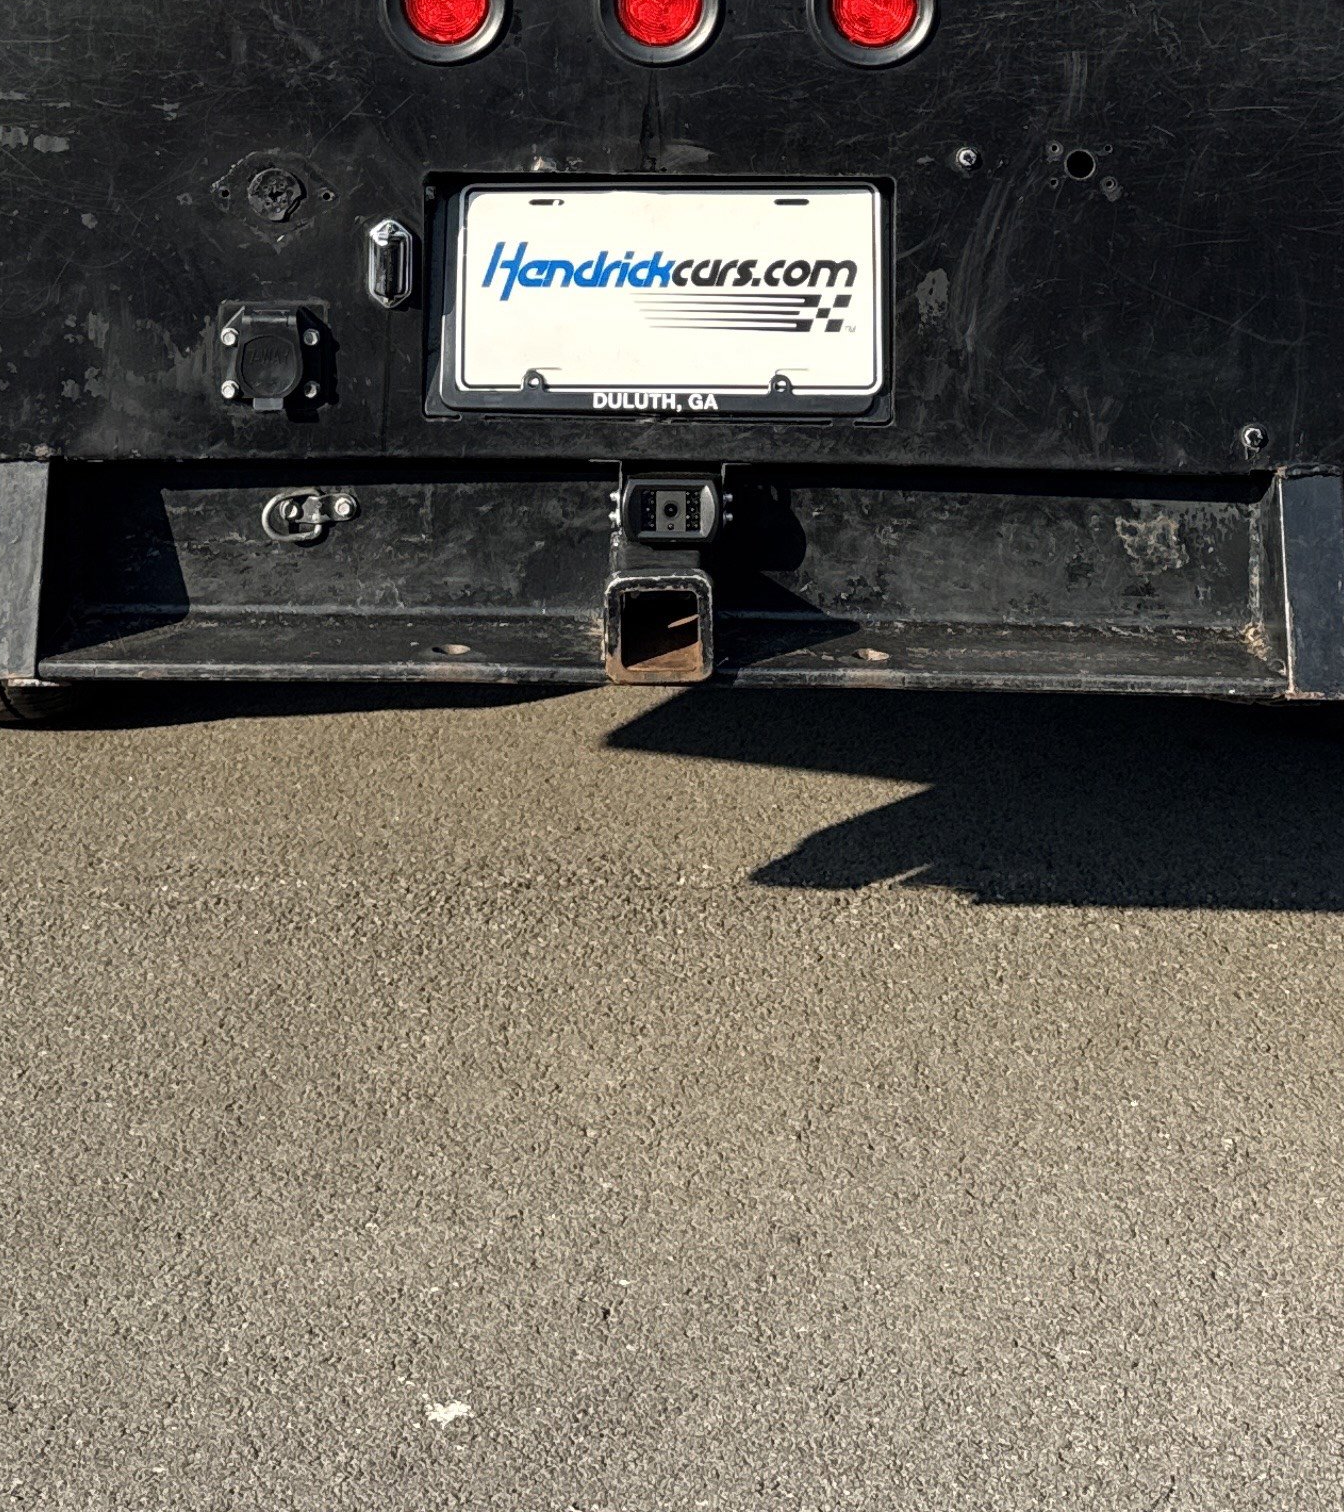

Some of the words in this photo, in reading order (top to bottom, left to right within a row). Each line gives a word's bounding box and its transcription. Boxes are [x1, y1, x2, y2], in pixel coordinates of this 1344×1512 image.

[482, 241, 857, 302] Hendrickcars.com
[593, 392, 682, 412] DULUTH,
[688, 393, 718, 410] GA
